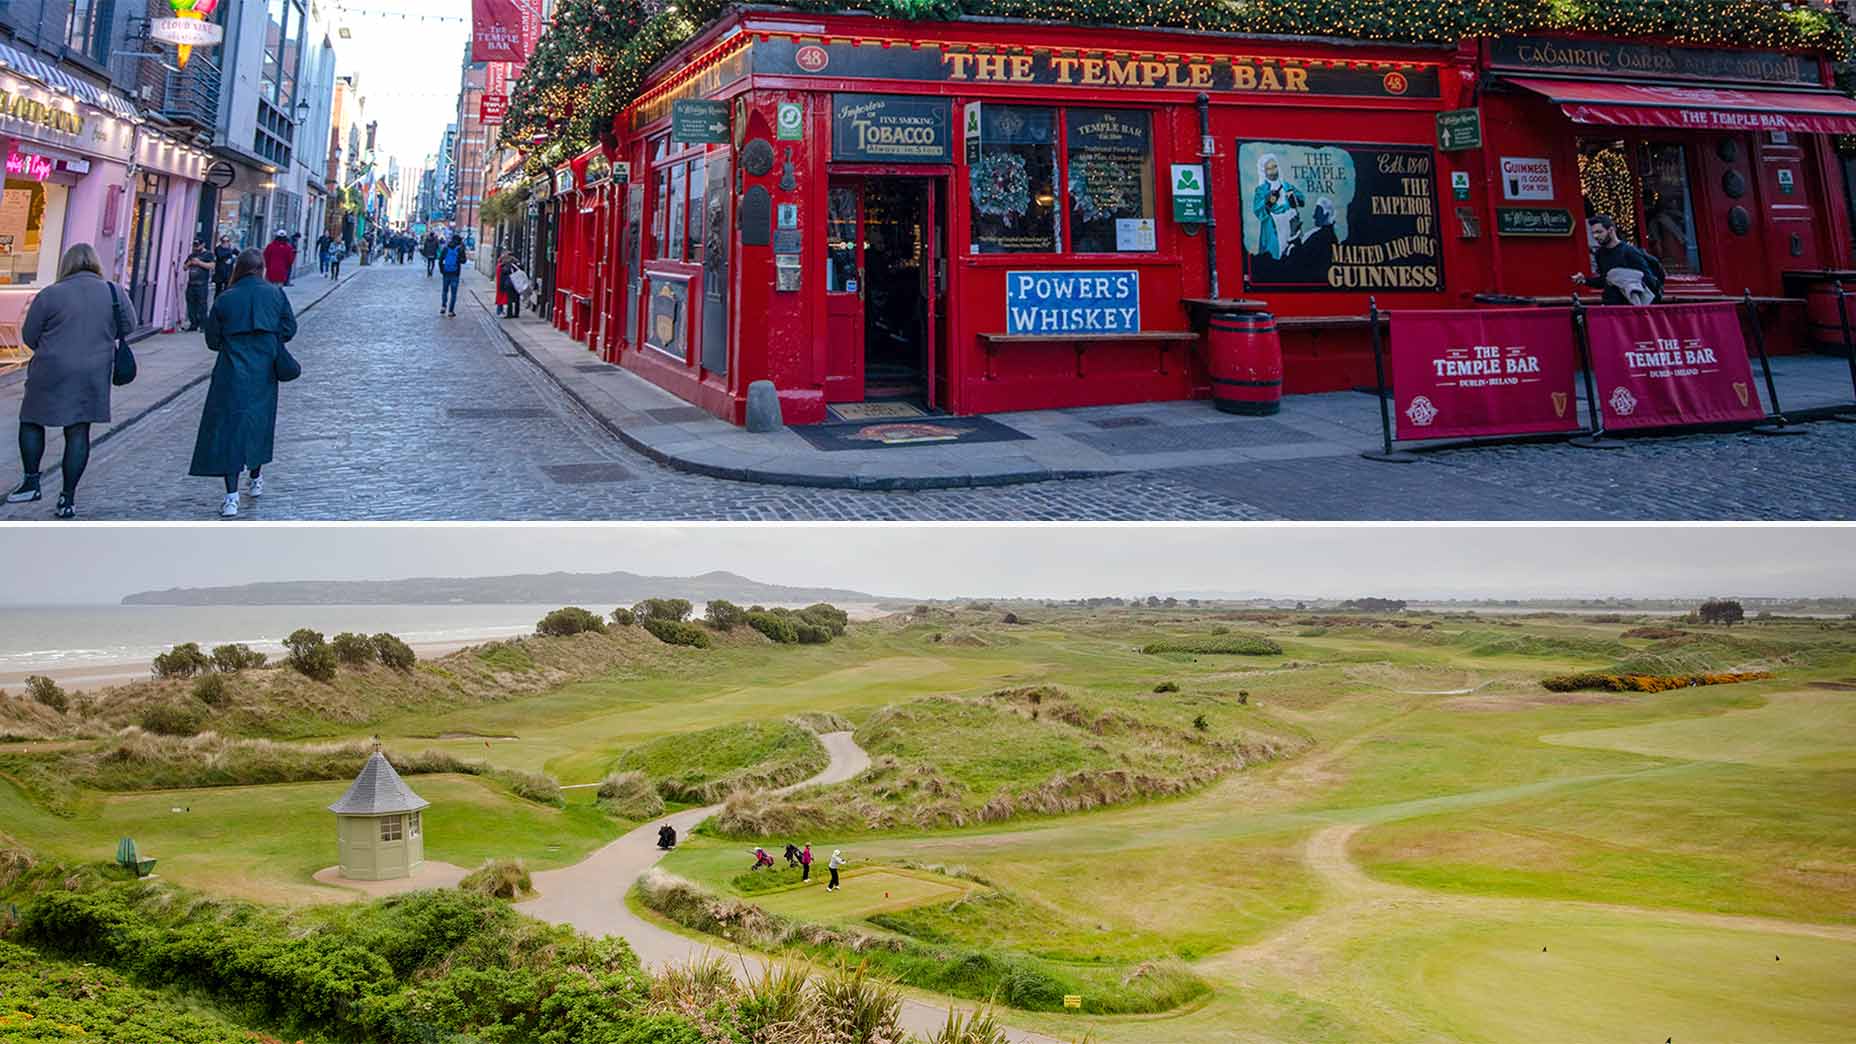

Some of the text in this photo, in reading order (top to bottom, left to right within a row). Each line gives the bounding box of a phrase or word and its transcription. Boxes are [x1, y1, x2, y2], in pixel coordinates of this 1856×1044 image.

[476, 32, 519, 43] TEMPLE
[487, 42, 510, 50] BAR
[800, 51, 821, 66] 48
[943, 52, 1309, 92] THE TEMPLE BAR
[838, 101, 886, 119] Importers
[1680, 109, 1786, 127] THE TEMPLE BAR
[880, 116, 934, 125] FINE SMOKING
[1077, 122, 1142, 137] TEMPLE BAR
[851, 120, 935, 150] TOBACCO
[1304, 152, 1332, 166] THE
[1504, 161, 1549, 174] GUINNESS
[1291, 166, 1346, 180] TEMPLE
[1306, 180, 1335, 194] BAR
[1401, 178, 1429, 196] THE
[1371, 196, 1432, 216] EMPEROR
[1416, 216, 1432, 234] OF
[1331, 235, 1437, 265] MALTED LIQUORS
[1328, 265, 1437, 288] GUINNESS
[1011, 306, 1136, 331] WHISKEY
[1473, 346, 1500, 358] THE
[1656, 338, 1680, 350] THE
[1433, 356, 1540, 376] TEMPLE BAR
[1625, 348, 1717, 368] TEMPLE BAR
